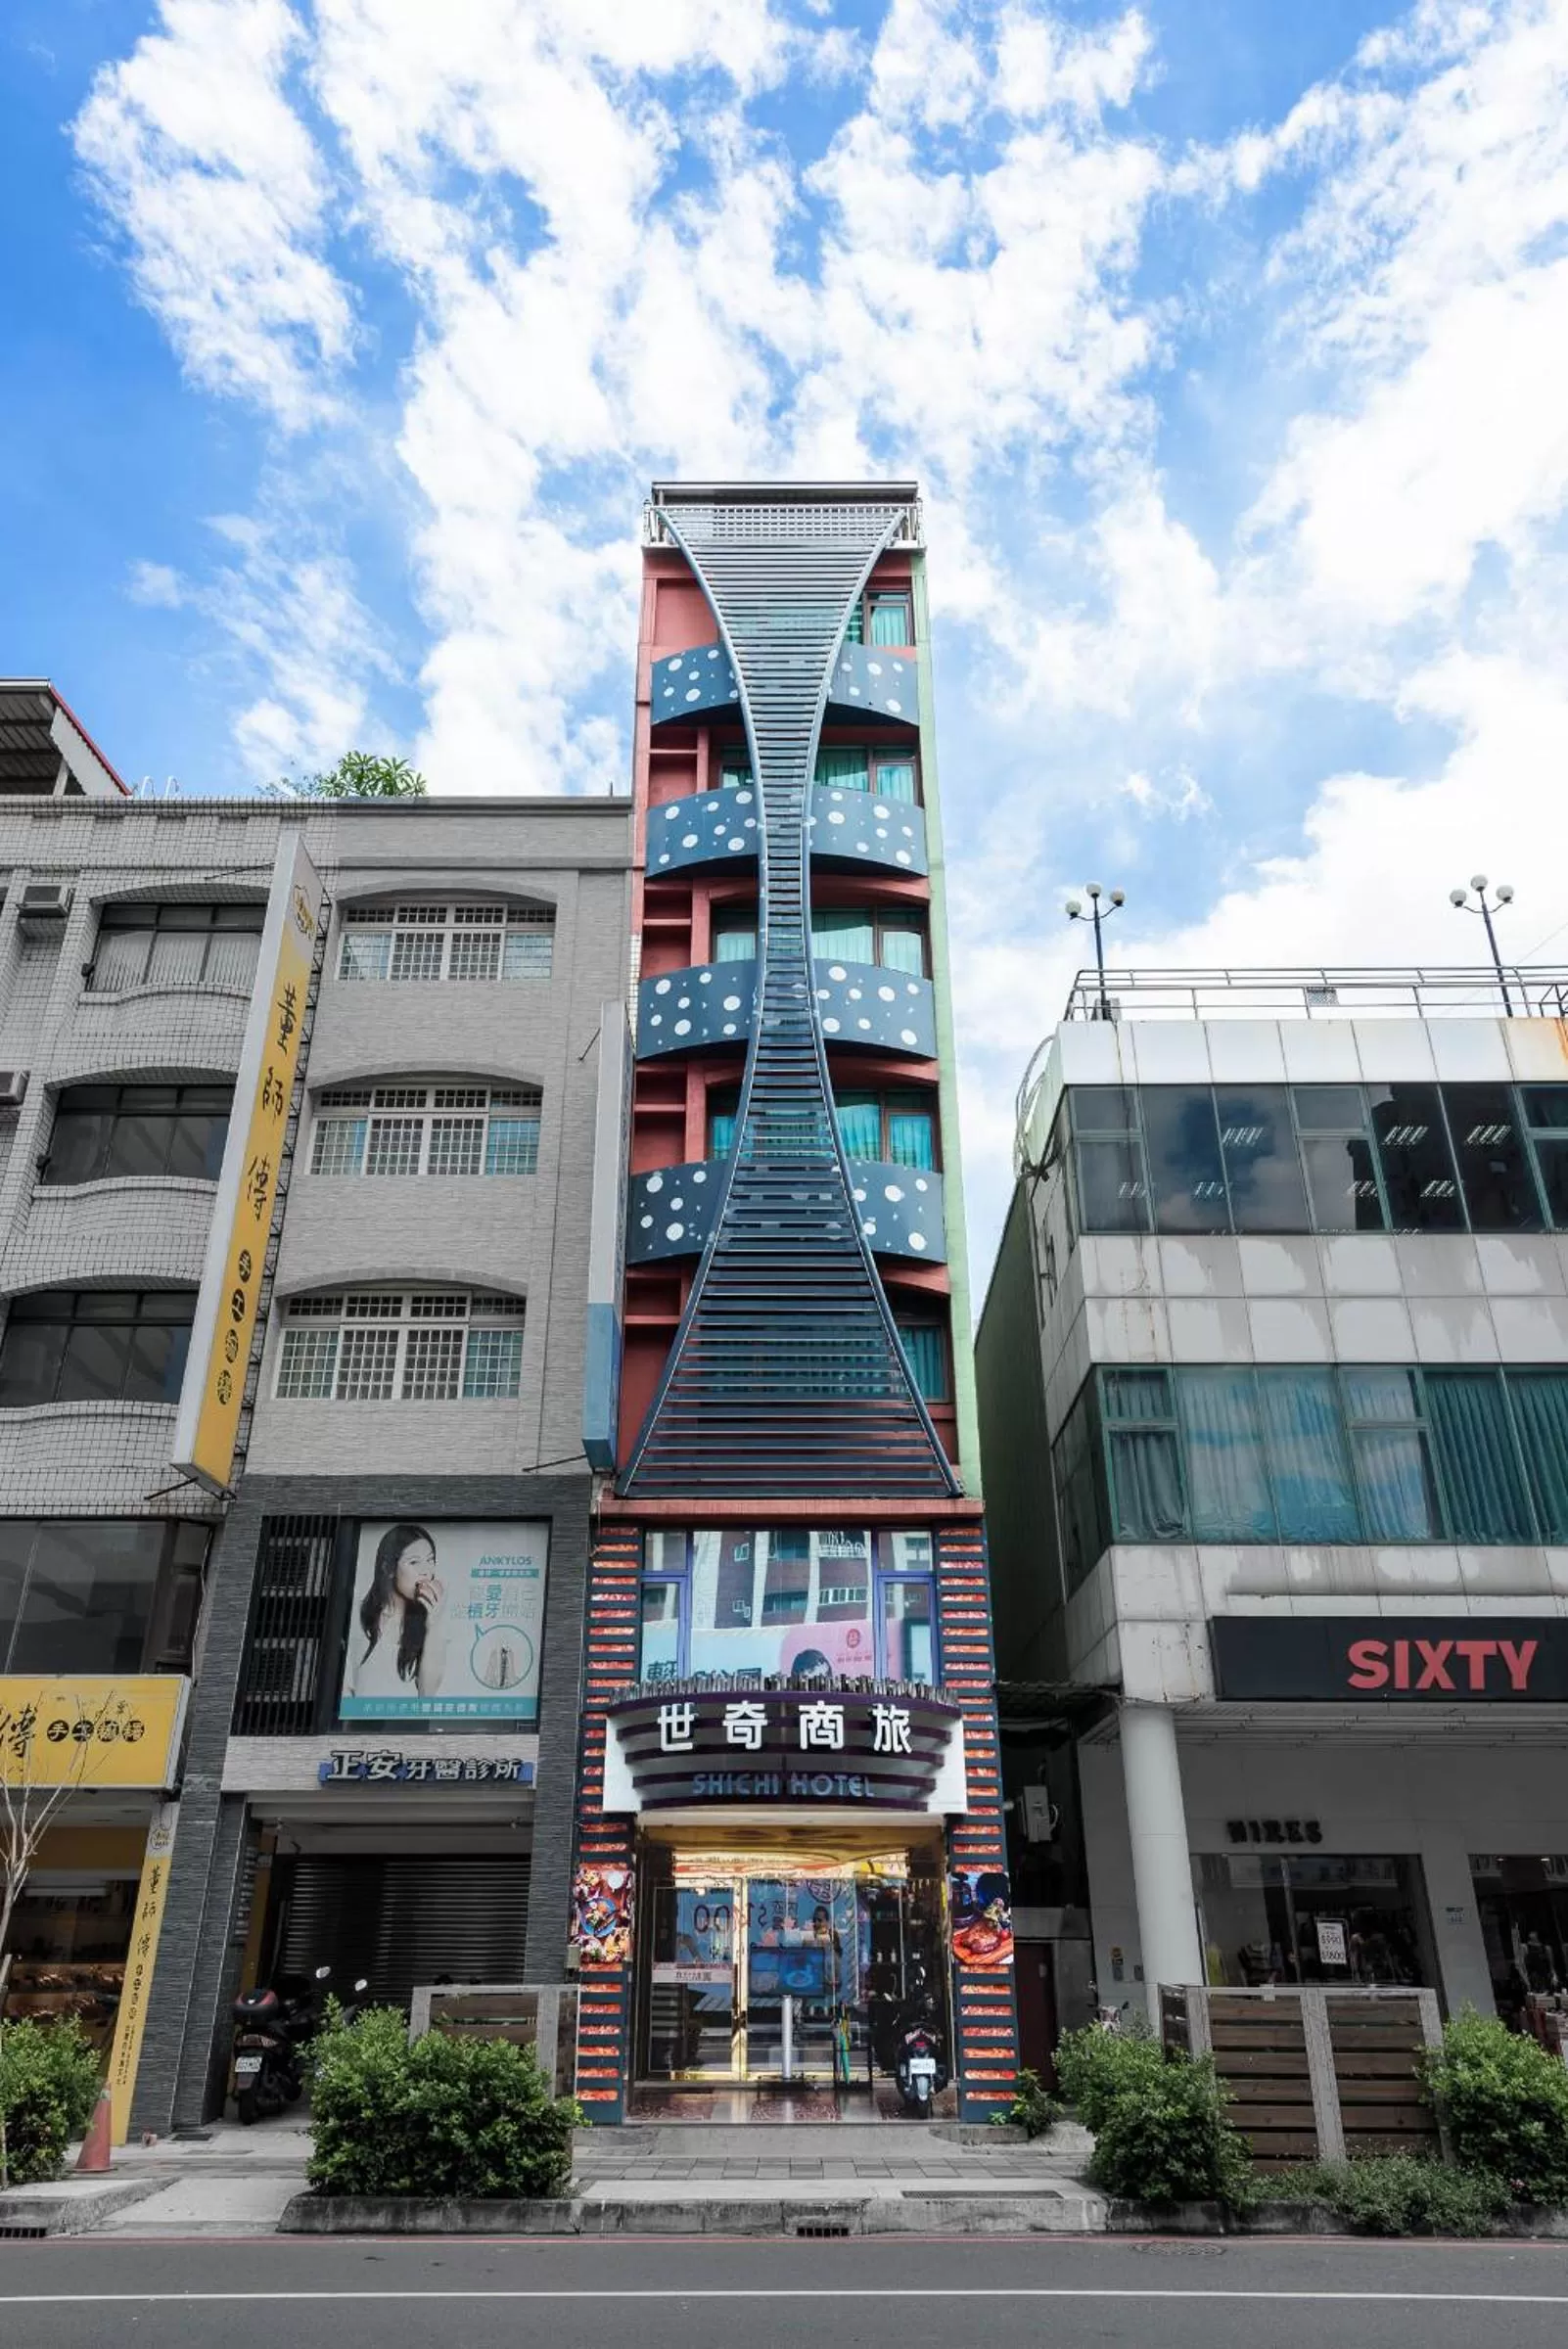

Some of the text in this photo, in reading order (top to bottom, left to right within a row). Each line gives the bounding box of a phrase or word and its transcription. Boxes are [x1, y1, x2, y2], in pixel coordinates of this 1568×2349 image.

[1346, 1638, 1539, 1691] SIXTY
[657, 1700, 912, 1754] 世奇商旅
[327, 1749, 522, 1781] 正安牙醫診所
[692, 1773, 875, 1798] SHICHI HOTEL
